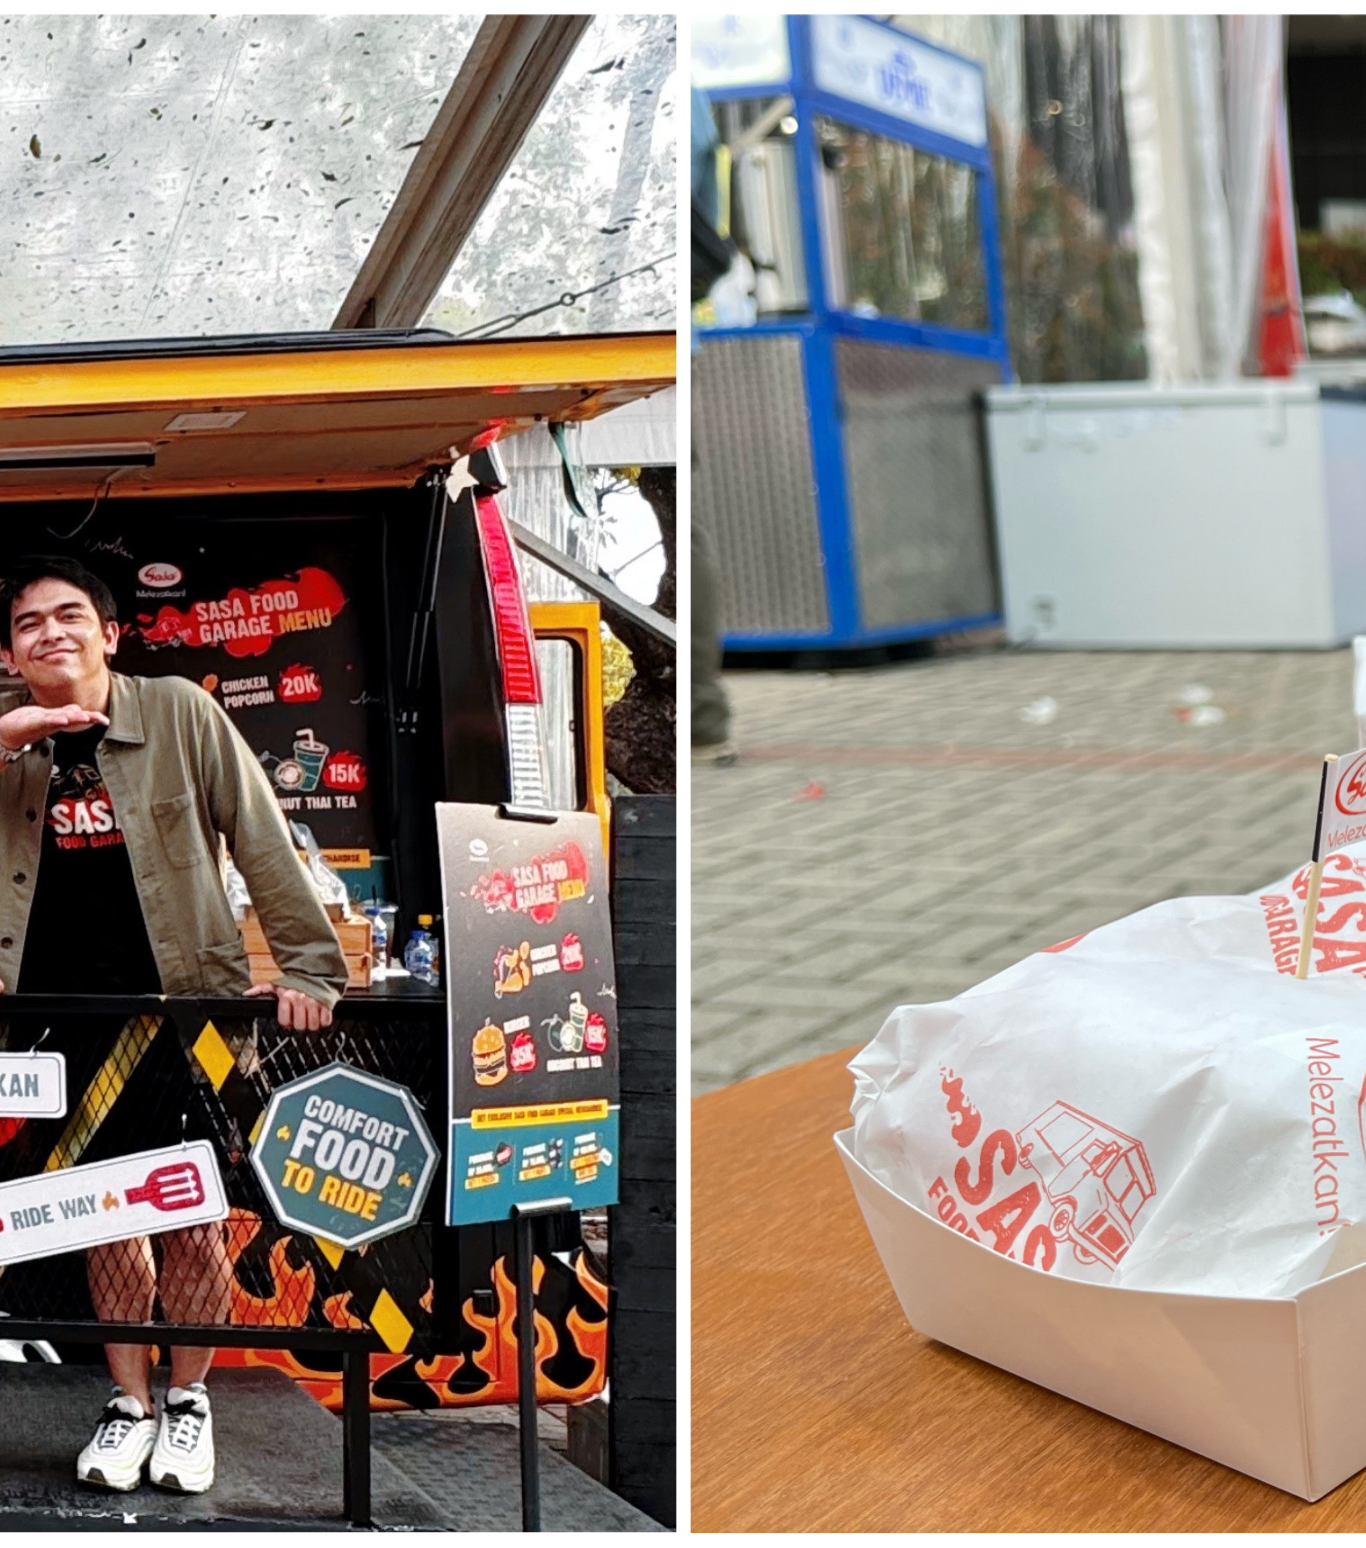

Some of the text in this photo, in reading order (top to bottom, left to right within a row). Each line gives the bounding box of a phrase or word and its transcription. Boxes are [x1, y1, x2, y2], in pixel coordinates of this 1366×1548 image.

[196, 590, 299, 623] SASA FOOD
[199, 608, 332, 644] GARAGE MENU
[221, 675, 269, 695] CHICKEN
[223, 690, 275, 710] POPCORN
[283, 674, 319, 697] 20K
[328, 762, 360, 784] 15K
[51, 800, 121, 835] SAS
[305, 796, 332, 809] THAI
[335, 796, 358, 809] TEA
[55, 833, 126, 850] FOOD GARA
[512, 864, 541, 888] SASA
[304, 1093, 410, 1148] COMFORT
[1305, 1037, 1354, 1237] Melezatkan!
[289, 1119, 397, 1191] FOOD
[282, 1159, 383, 1223] TO RIDE
[927, 1175, 981, 1242] FOO
[954, 1128, 1057, 1273] SAS
[10, 1194, 98, 1232] RIDE WAY
